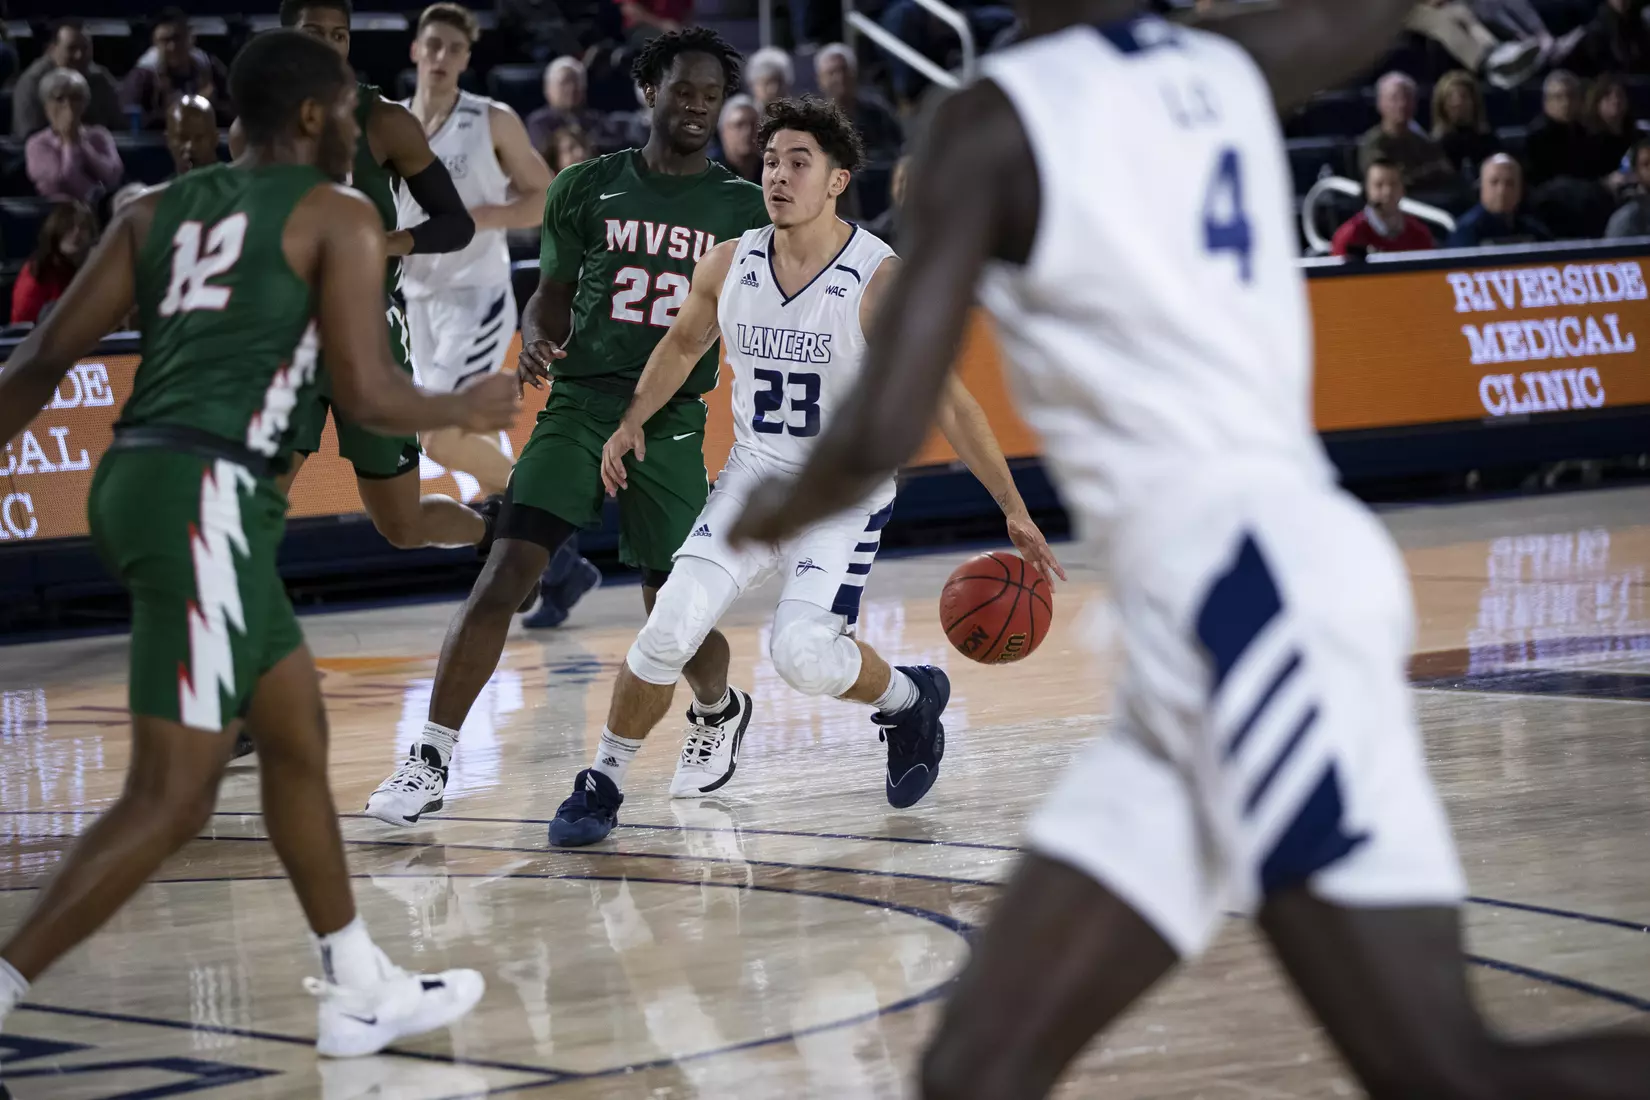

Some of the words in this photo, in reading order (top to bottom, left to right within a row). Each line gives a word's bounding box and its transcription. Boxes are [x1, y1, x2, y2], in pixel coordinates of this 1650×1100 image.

[604, 218, 716, 263] MVSU
[1201, 146, 1253, 284] 4
[159, 211, 248, 317] 12
[1446, 261, 1648, 313] RIVERSIDE
[610, 265, 691, 329] 22
[825, 285, 847, 298] WAC
[737, 323, 832, 363] LANCERS
[1461, 312, 1636, 365] MEDICAL
[43, 363, 115, 410] DE
[752, 367, 821, 437] 23
[1479, 366, 1605, 416] CLINIC
